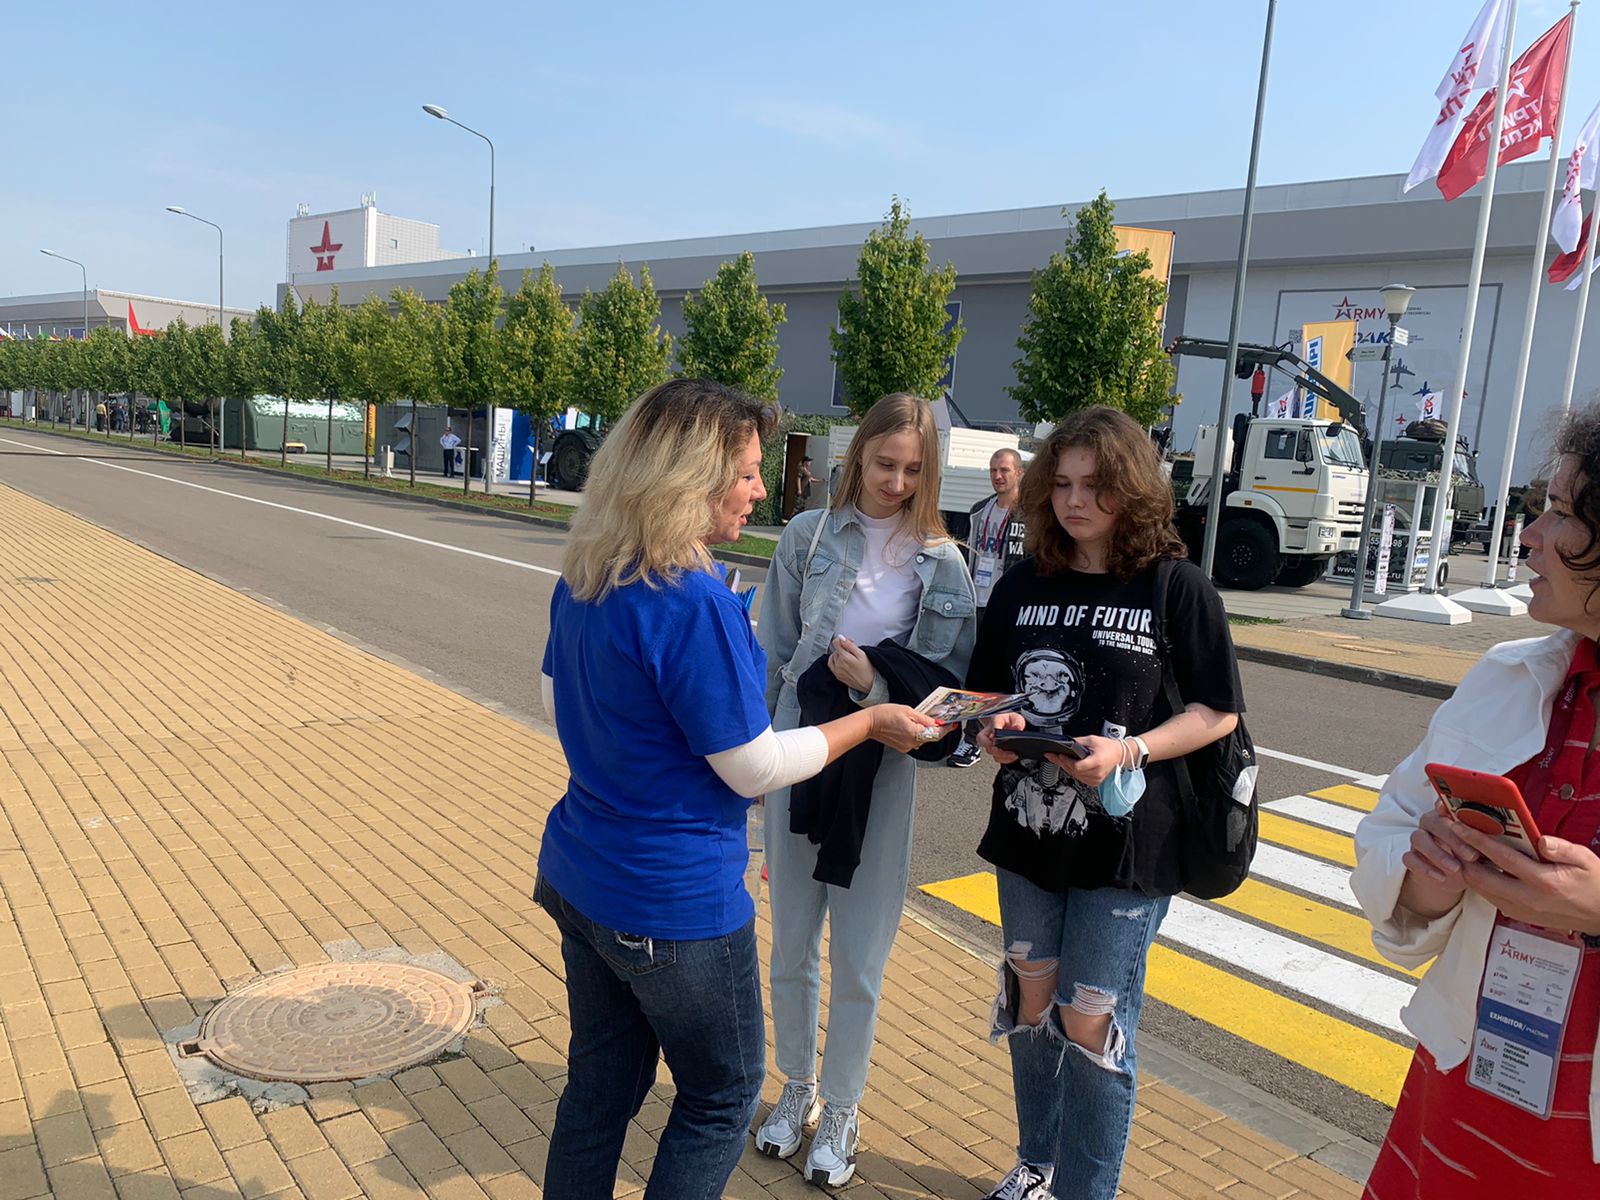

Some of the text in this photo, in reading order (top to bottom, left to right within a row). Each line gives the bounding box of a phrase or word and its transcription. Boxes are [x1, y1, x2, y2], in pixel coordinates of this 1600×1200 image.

[1332, 296, 1386, 320] ARMY
[496, 423, 506, 478] МАШИНЫ
[1015, 605, 1155, 634] MIND OF FUTUR
[1092, 630, 1135, 644] UNIVERSAL
[1500, 939, 1536, 965] ARMY
